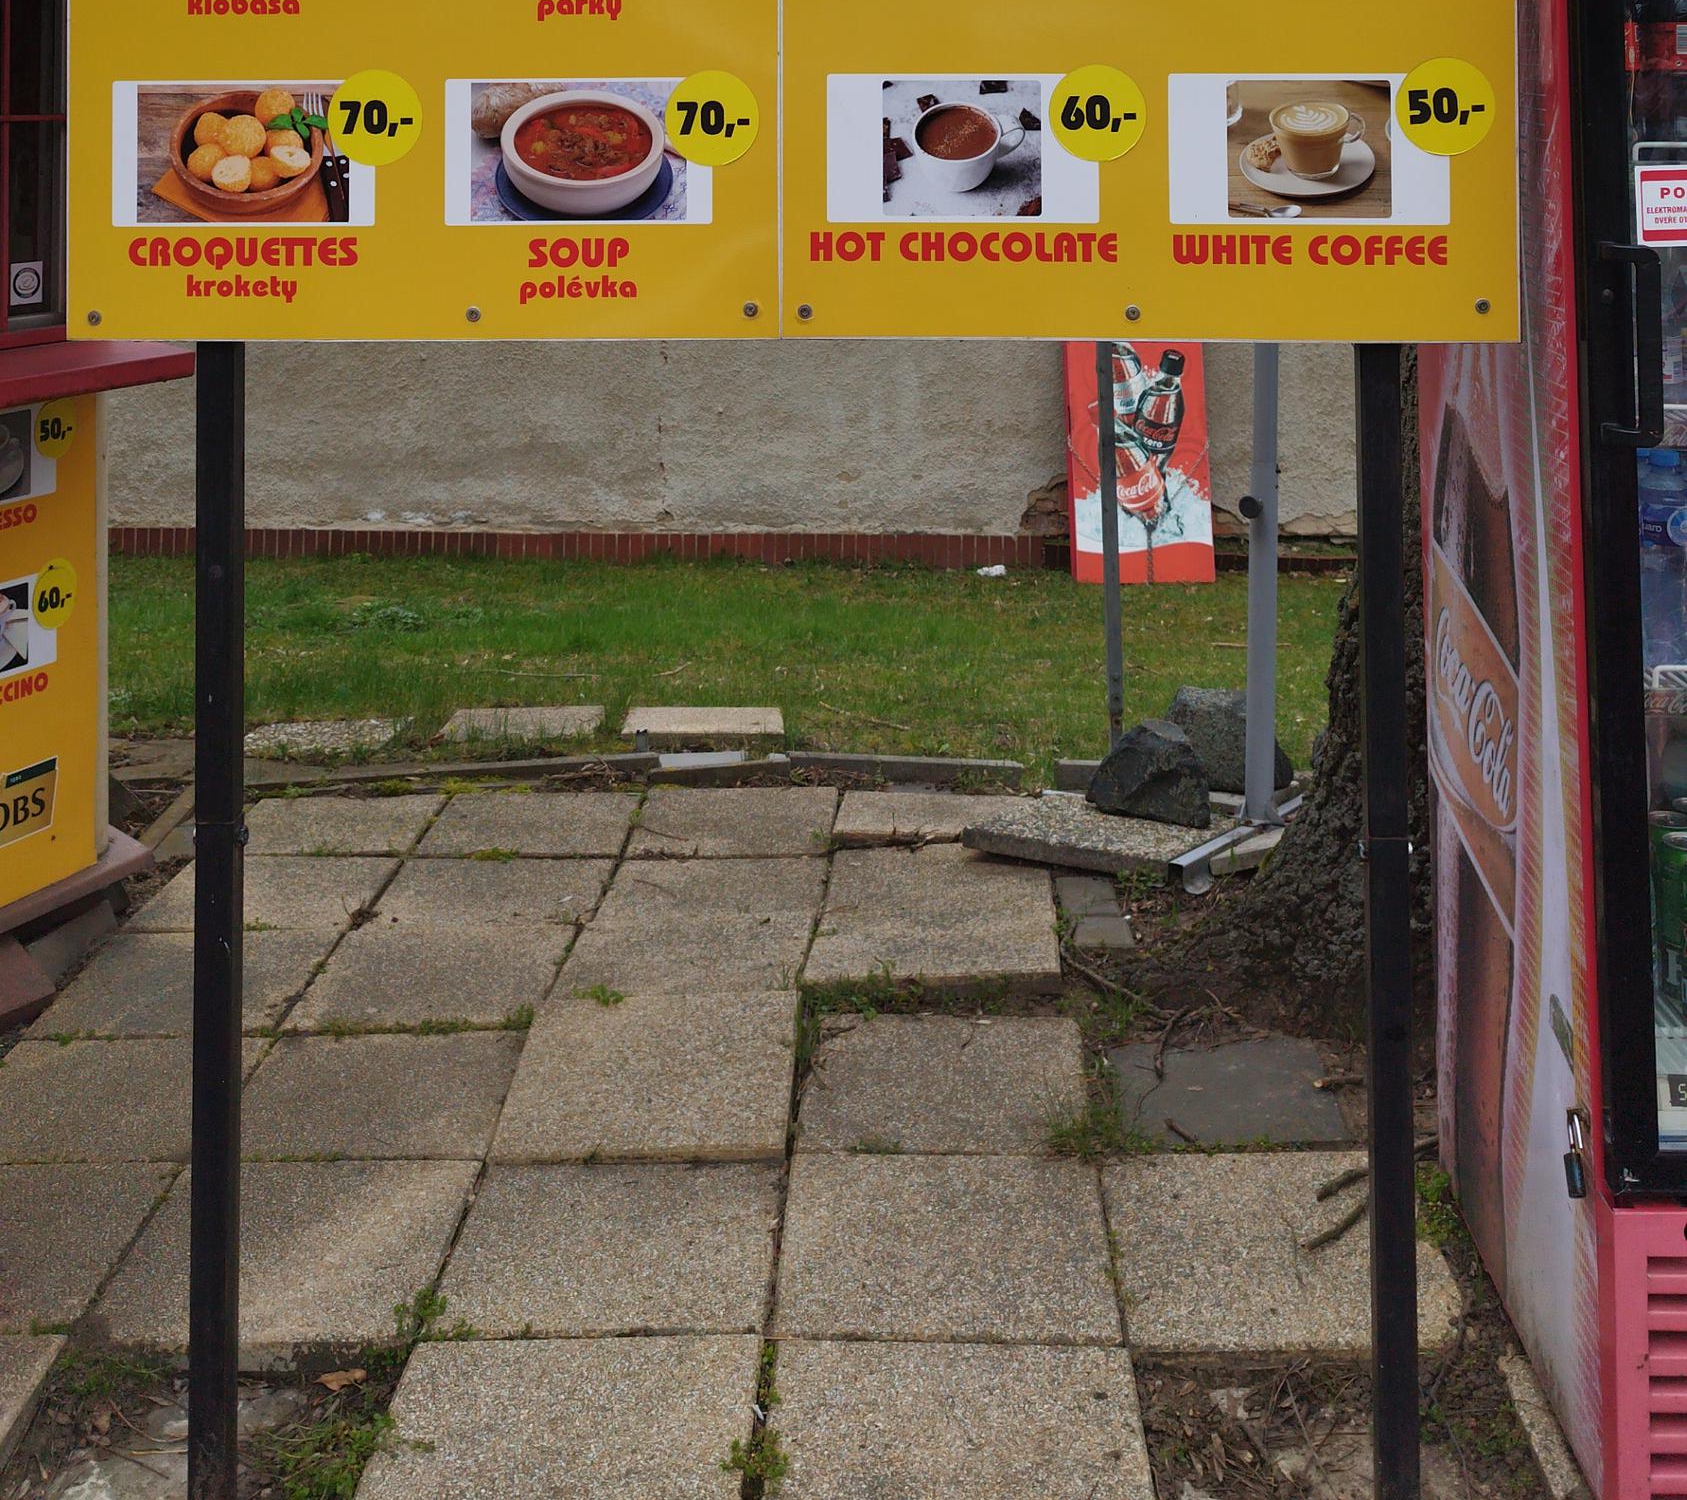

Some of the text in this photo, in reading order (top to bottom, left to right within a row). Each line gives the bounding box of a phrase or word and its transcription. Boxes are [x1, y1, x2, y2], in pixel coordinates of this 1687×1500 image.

[339, 99, 414, 138] 70,-
[676, 100, 750, 138] 70,-
[1060, 94, 1137, 133] 60,-
[1407, 87, 1486, 126] 50,-
[1659, 186, 1686, 199] PO
[127, 236, 358, 271] CROQUETTES
[527, 237, 630, 269] SOUP
[809, 231, 1118, 263] HOT CHOCOLATE
[1172, 234, 1448, 266] WHITE COFFEE
[186, 274, 297, 303] krokety
[518, 275, 638, 305] polévka
[40, 417, 73, 442] 50,-
[0, 503, 38, 530] SSO
[37, 586, 73, 612] 60,-
[0, 672, 49, 705] CINO
